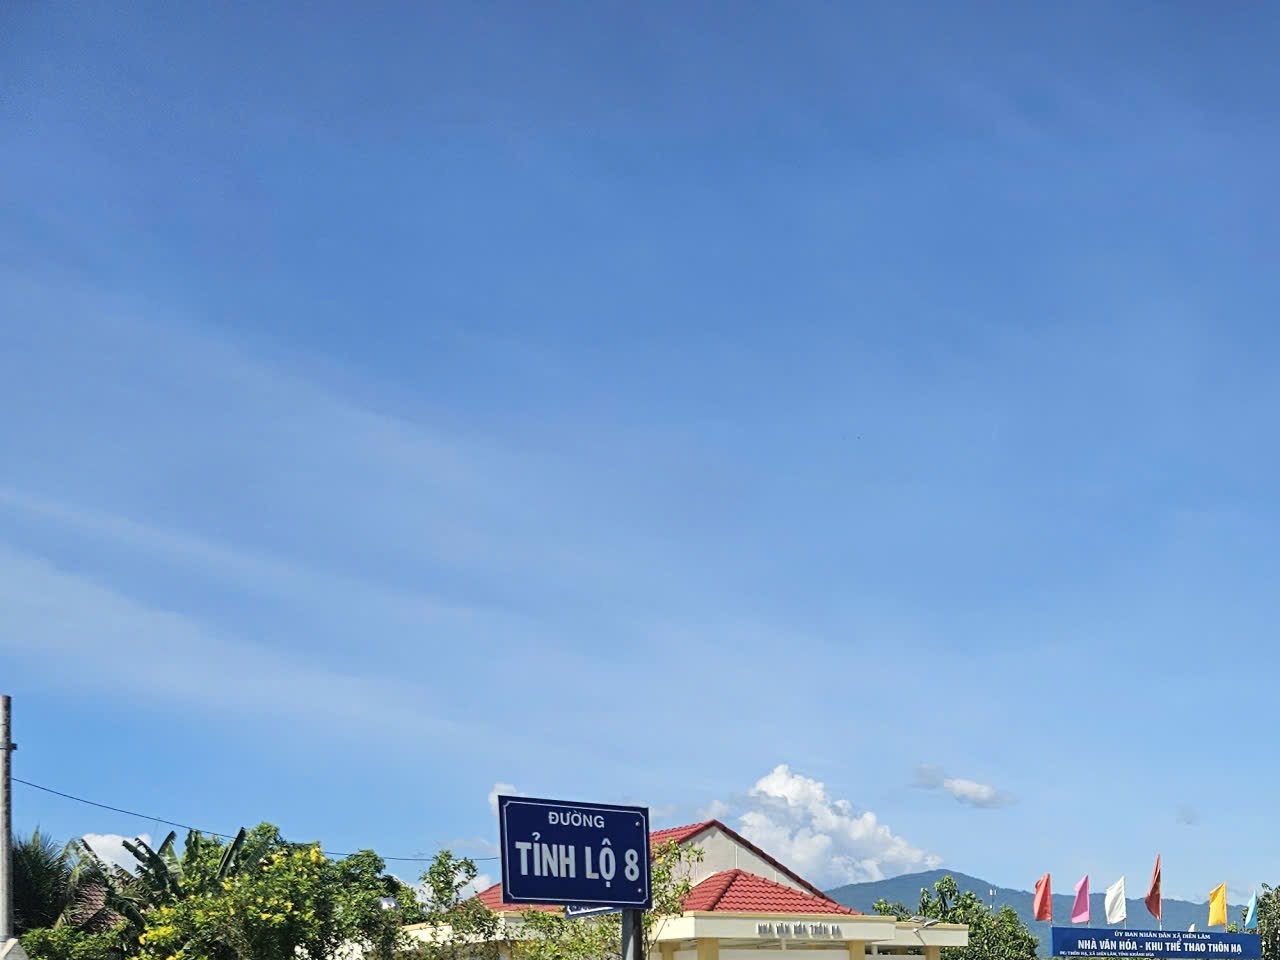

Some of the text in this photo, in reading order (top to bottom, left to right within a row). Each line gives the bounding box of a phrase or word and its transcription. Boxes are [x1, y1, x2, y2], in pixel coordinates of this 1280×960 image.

[548, 810, 605, 828] ĐƯỜNG
[515, 832, 640, 888] TỈNH LỘ 8
[1078, 937, 1097, 950] NHÀ
[1100, 938, 1117, 950] VĂN
[1119, 938, 1137, 951] HÓA
[1145, 941, 1162, 951] KHU
[1165, 938, 1182, 952] THỂ
[1184, 942, 1206, 952] THAO
[1207, 940, 1229, 953] THÔN
[1231, 943, 1242, 955] HẠ
